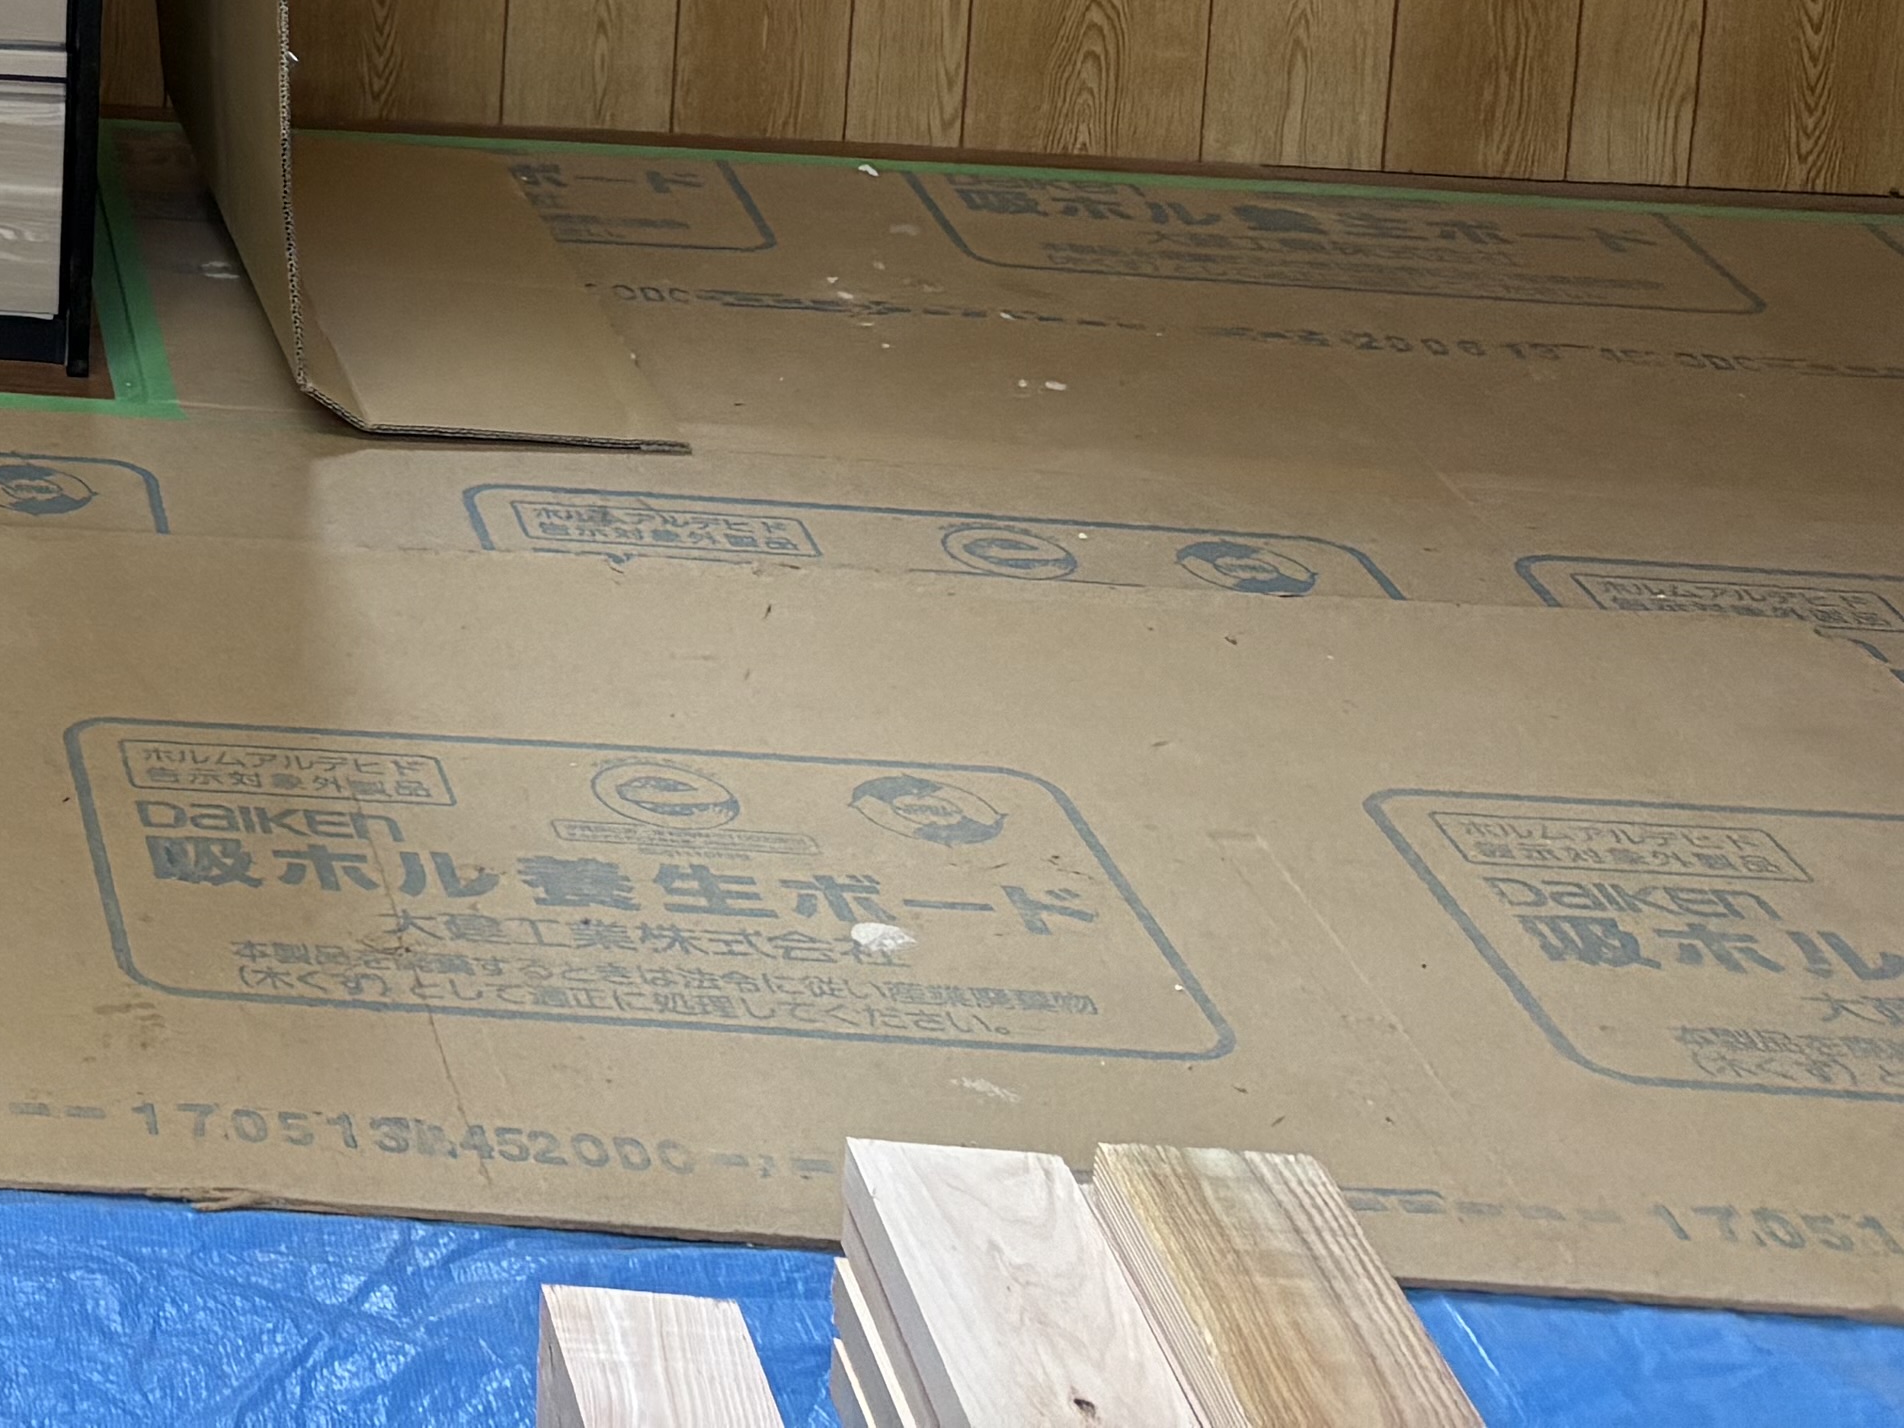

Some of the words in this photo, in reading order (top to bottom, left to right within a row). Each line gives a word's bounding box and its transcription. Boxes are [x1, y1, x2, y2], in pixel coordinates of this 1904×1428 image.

[143, 747, 426, 778] ホルムアルデヒド
[145, 765, 433, 800] 告示対象外製品
[1457, 819, 1762, 851] ホルムアルデヒド
[144, 835, 1098, 935] 吸ホル養生ボード
